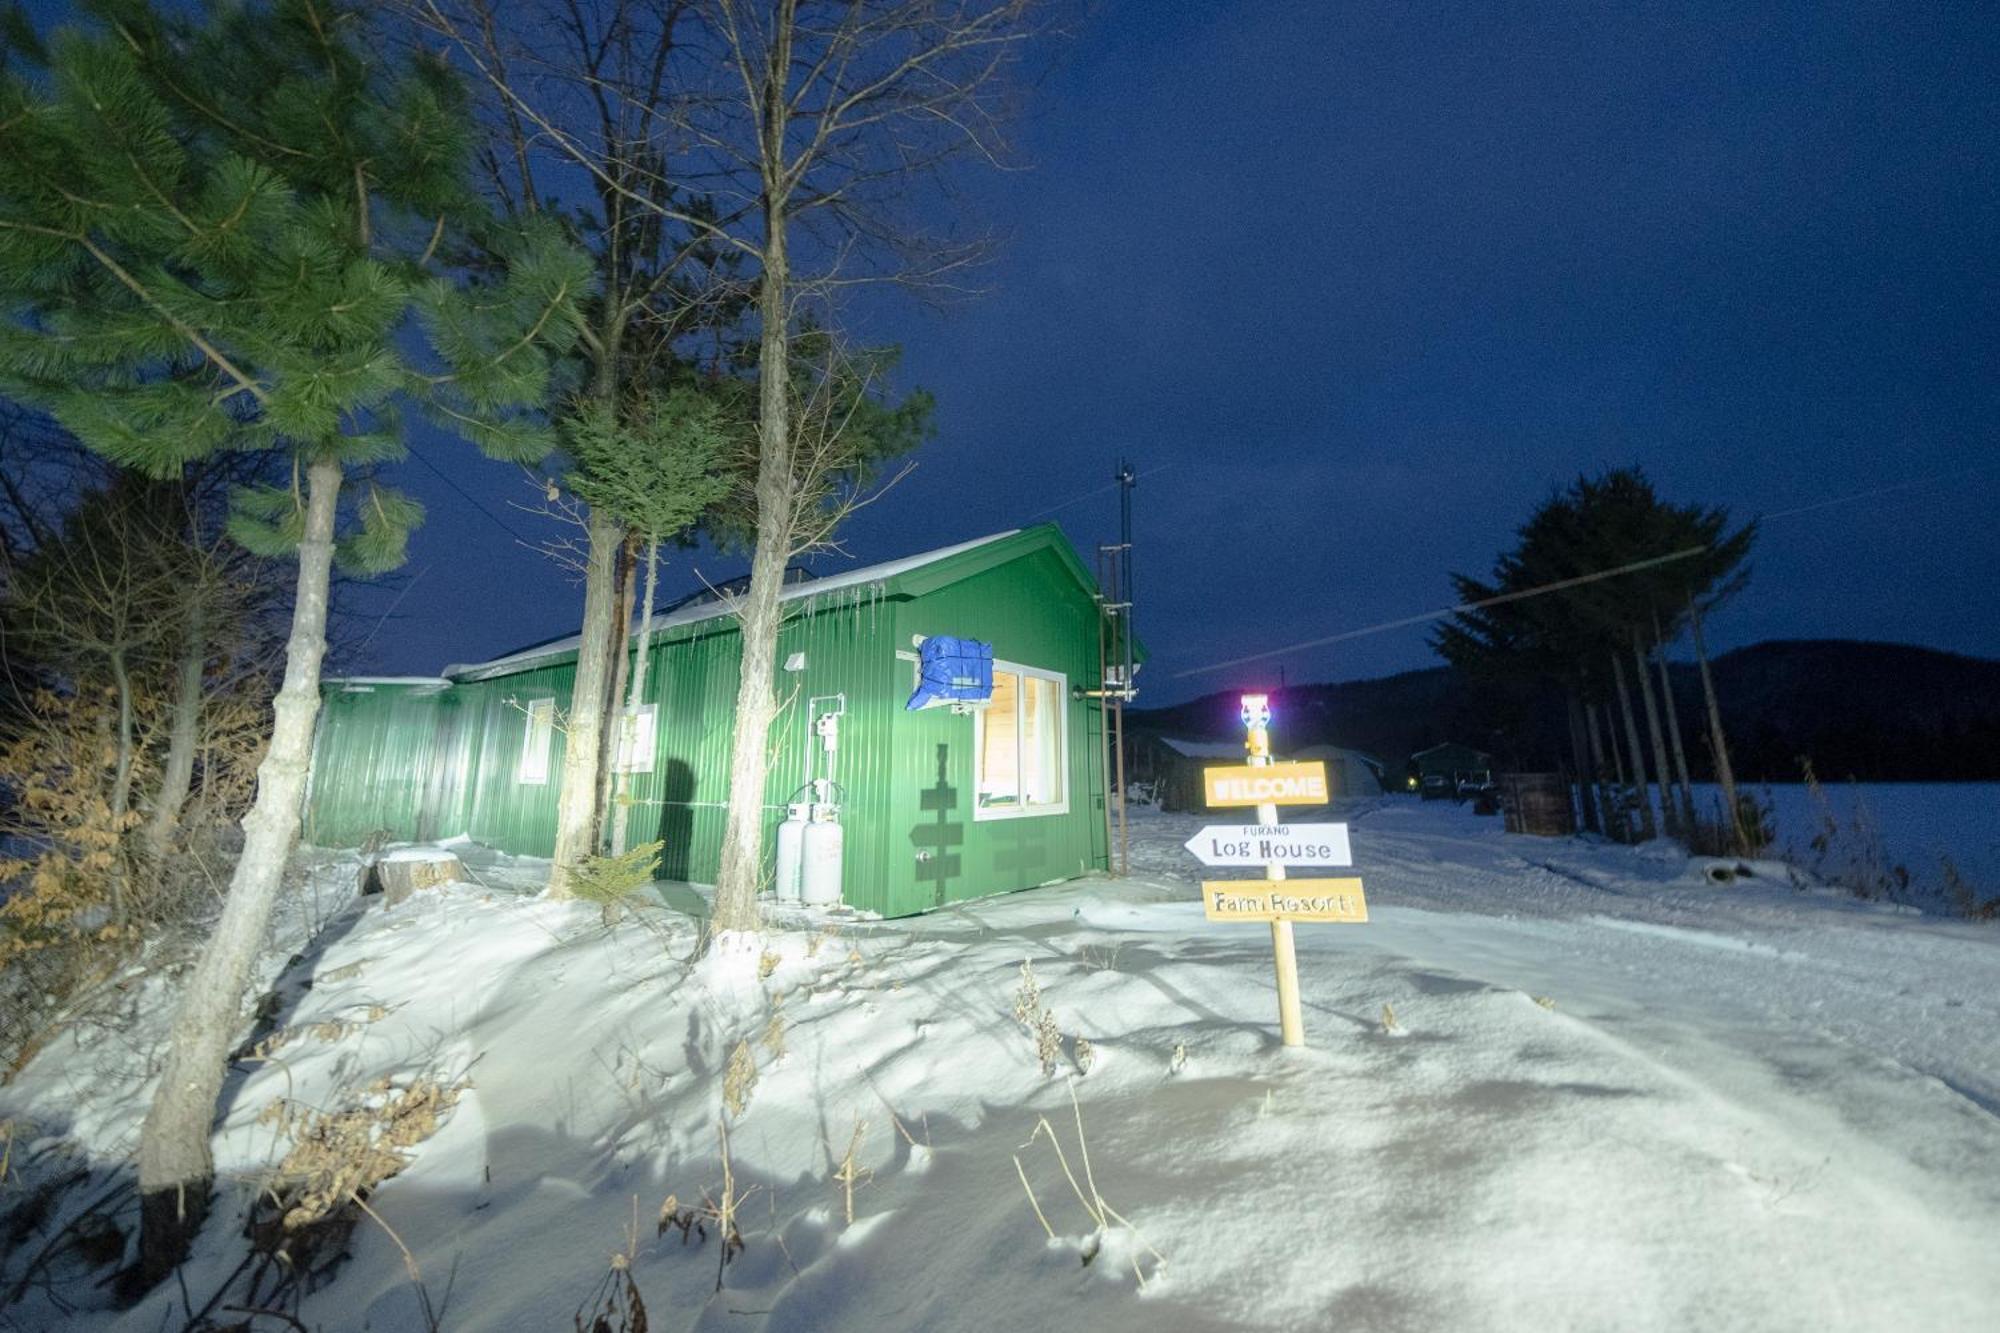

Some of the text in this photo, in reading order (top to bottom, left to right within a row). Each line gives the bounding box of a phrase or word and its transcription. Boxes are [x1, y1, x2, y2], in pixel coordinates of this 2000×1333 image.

[1214, 777, 1323, 800] WELCOME
[1243, 826, 1290, 837] FURANO
[1212, 838, 1331, 860] Log House
[1214, 892, 1265, 912] Farm
